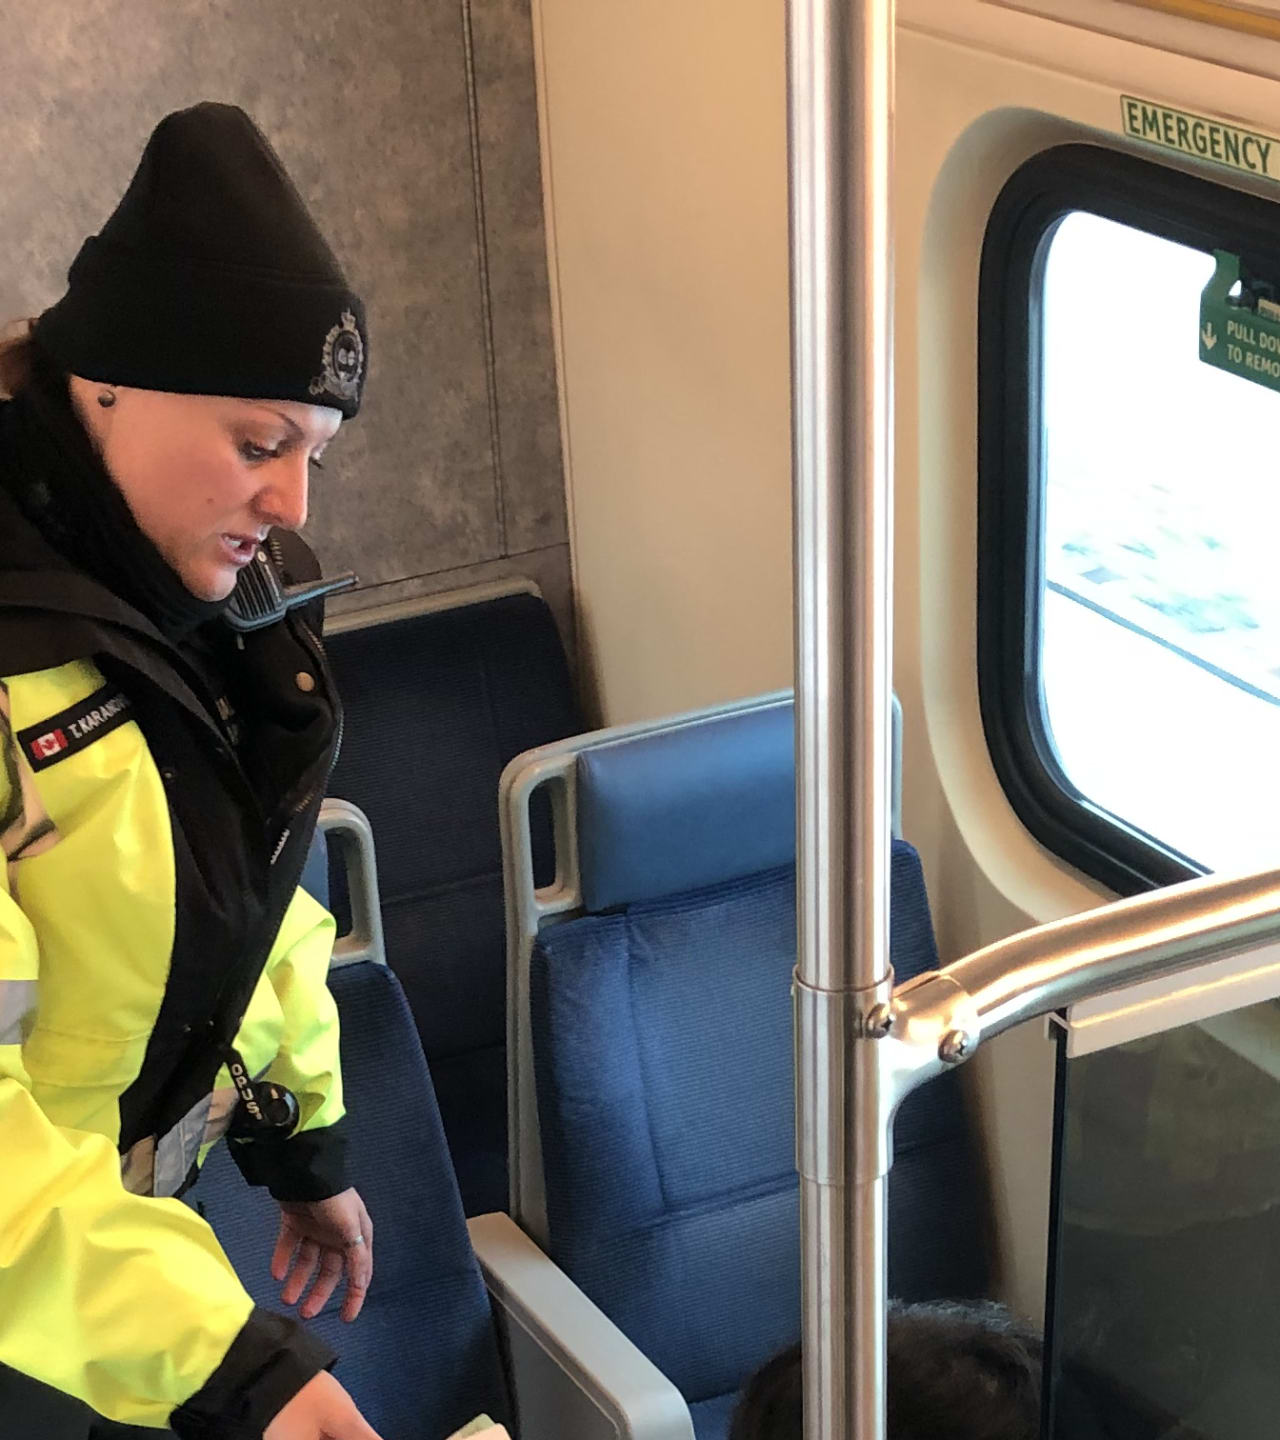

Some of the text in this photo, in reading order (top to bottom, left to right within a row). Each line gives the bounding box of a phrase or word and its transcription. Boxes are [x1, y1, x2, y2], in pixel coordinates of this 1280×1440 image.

[1127, 101, 1271, 174] EMERGENCY
[1227, 320, 1256, 345] PULL
[1227, 344, 1242, 363] TO
